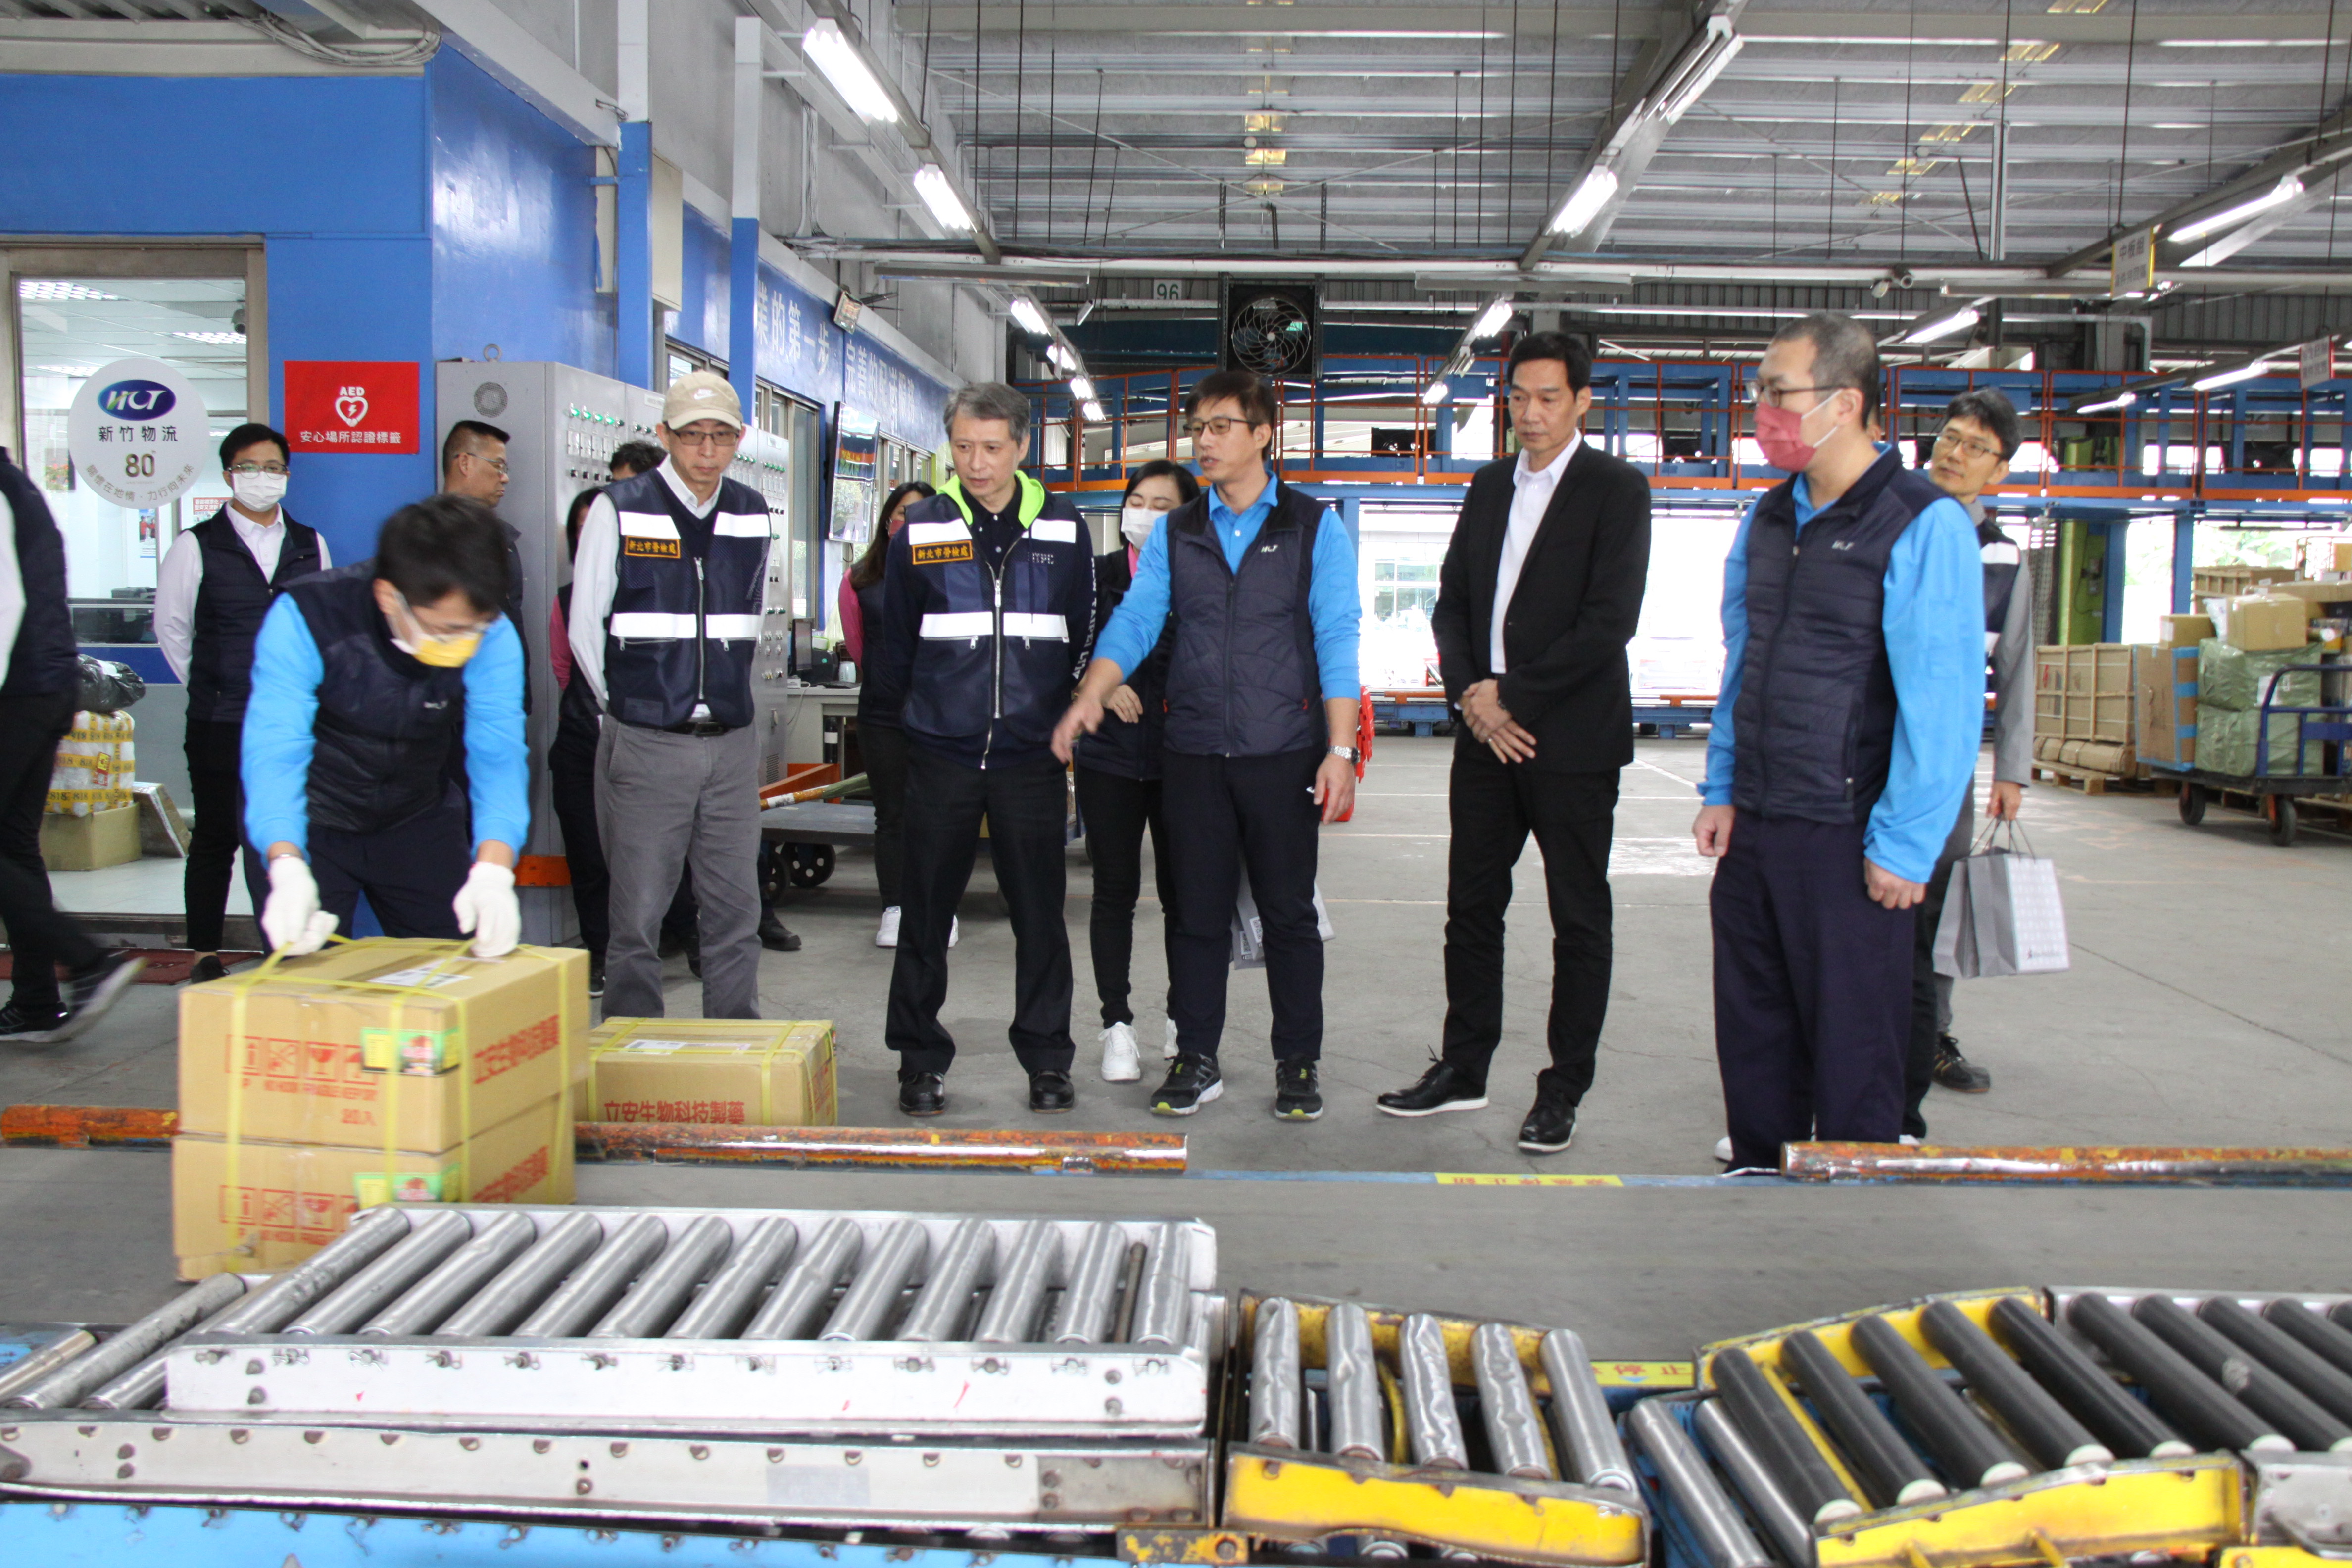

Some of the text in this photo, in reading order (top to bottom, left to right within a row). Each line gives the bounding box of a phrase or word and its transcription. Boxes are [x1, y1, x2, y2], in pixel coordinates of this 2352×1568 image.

[1157, 283, 1178, 300] 96
[340, 386, 365, 396] AED
[98, 425, 178, 442] 新竹物流
[300, 431, 401, 444] 安心場所認證標籤
